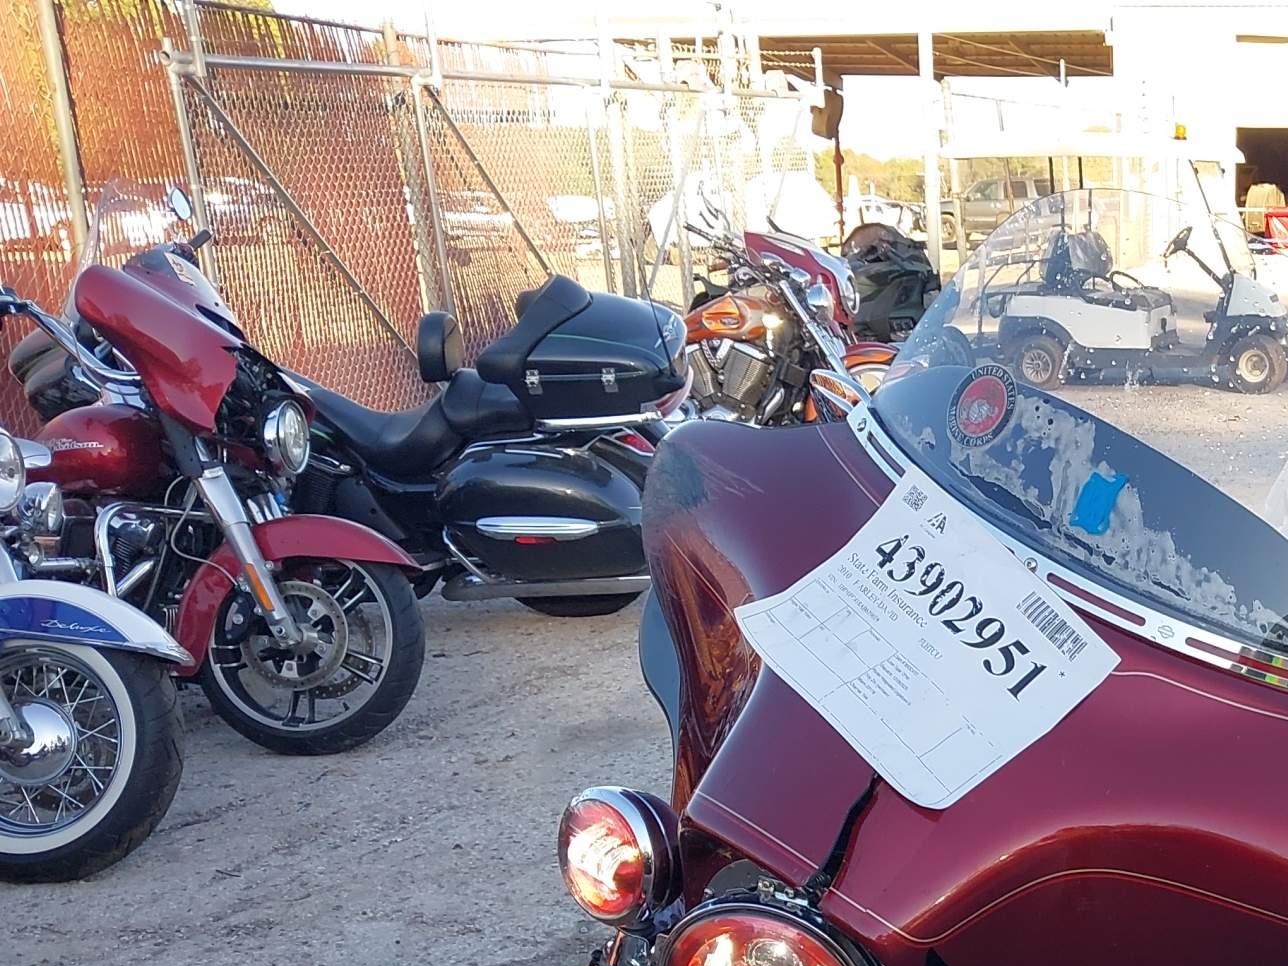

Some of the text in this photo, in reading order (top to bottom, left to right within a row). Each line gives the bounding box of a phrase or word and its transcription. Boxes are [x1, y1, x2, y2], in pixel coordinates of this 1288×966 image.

[971, 366, 1015, 410] UNITED STATES
[963, 432, 993, 446] CORPS
[848, 552, 869, 575] State
[867, 569, 889, 595] Farm
[887, 588, 928, 629] Insurance
[40, 619, 111, 632] Deluxe
[875, 534, 1047, 702] 43902951
